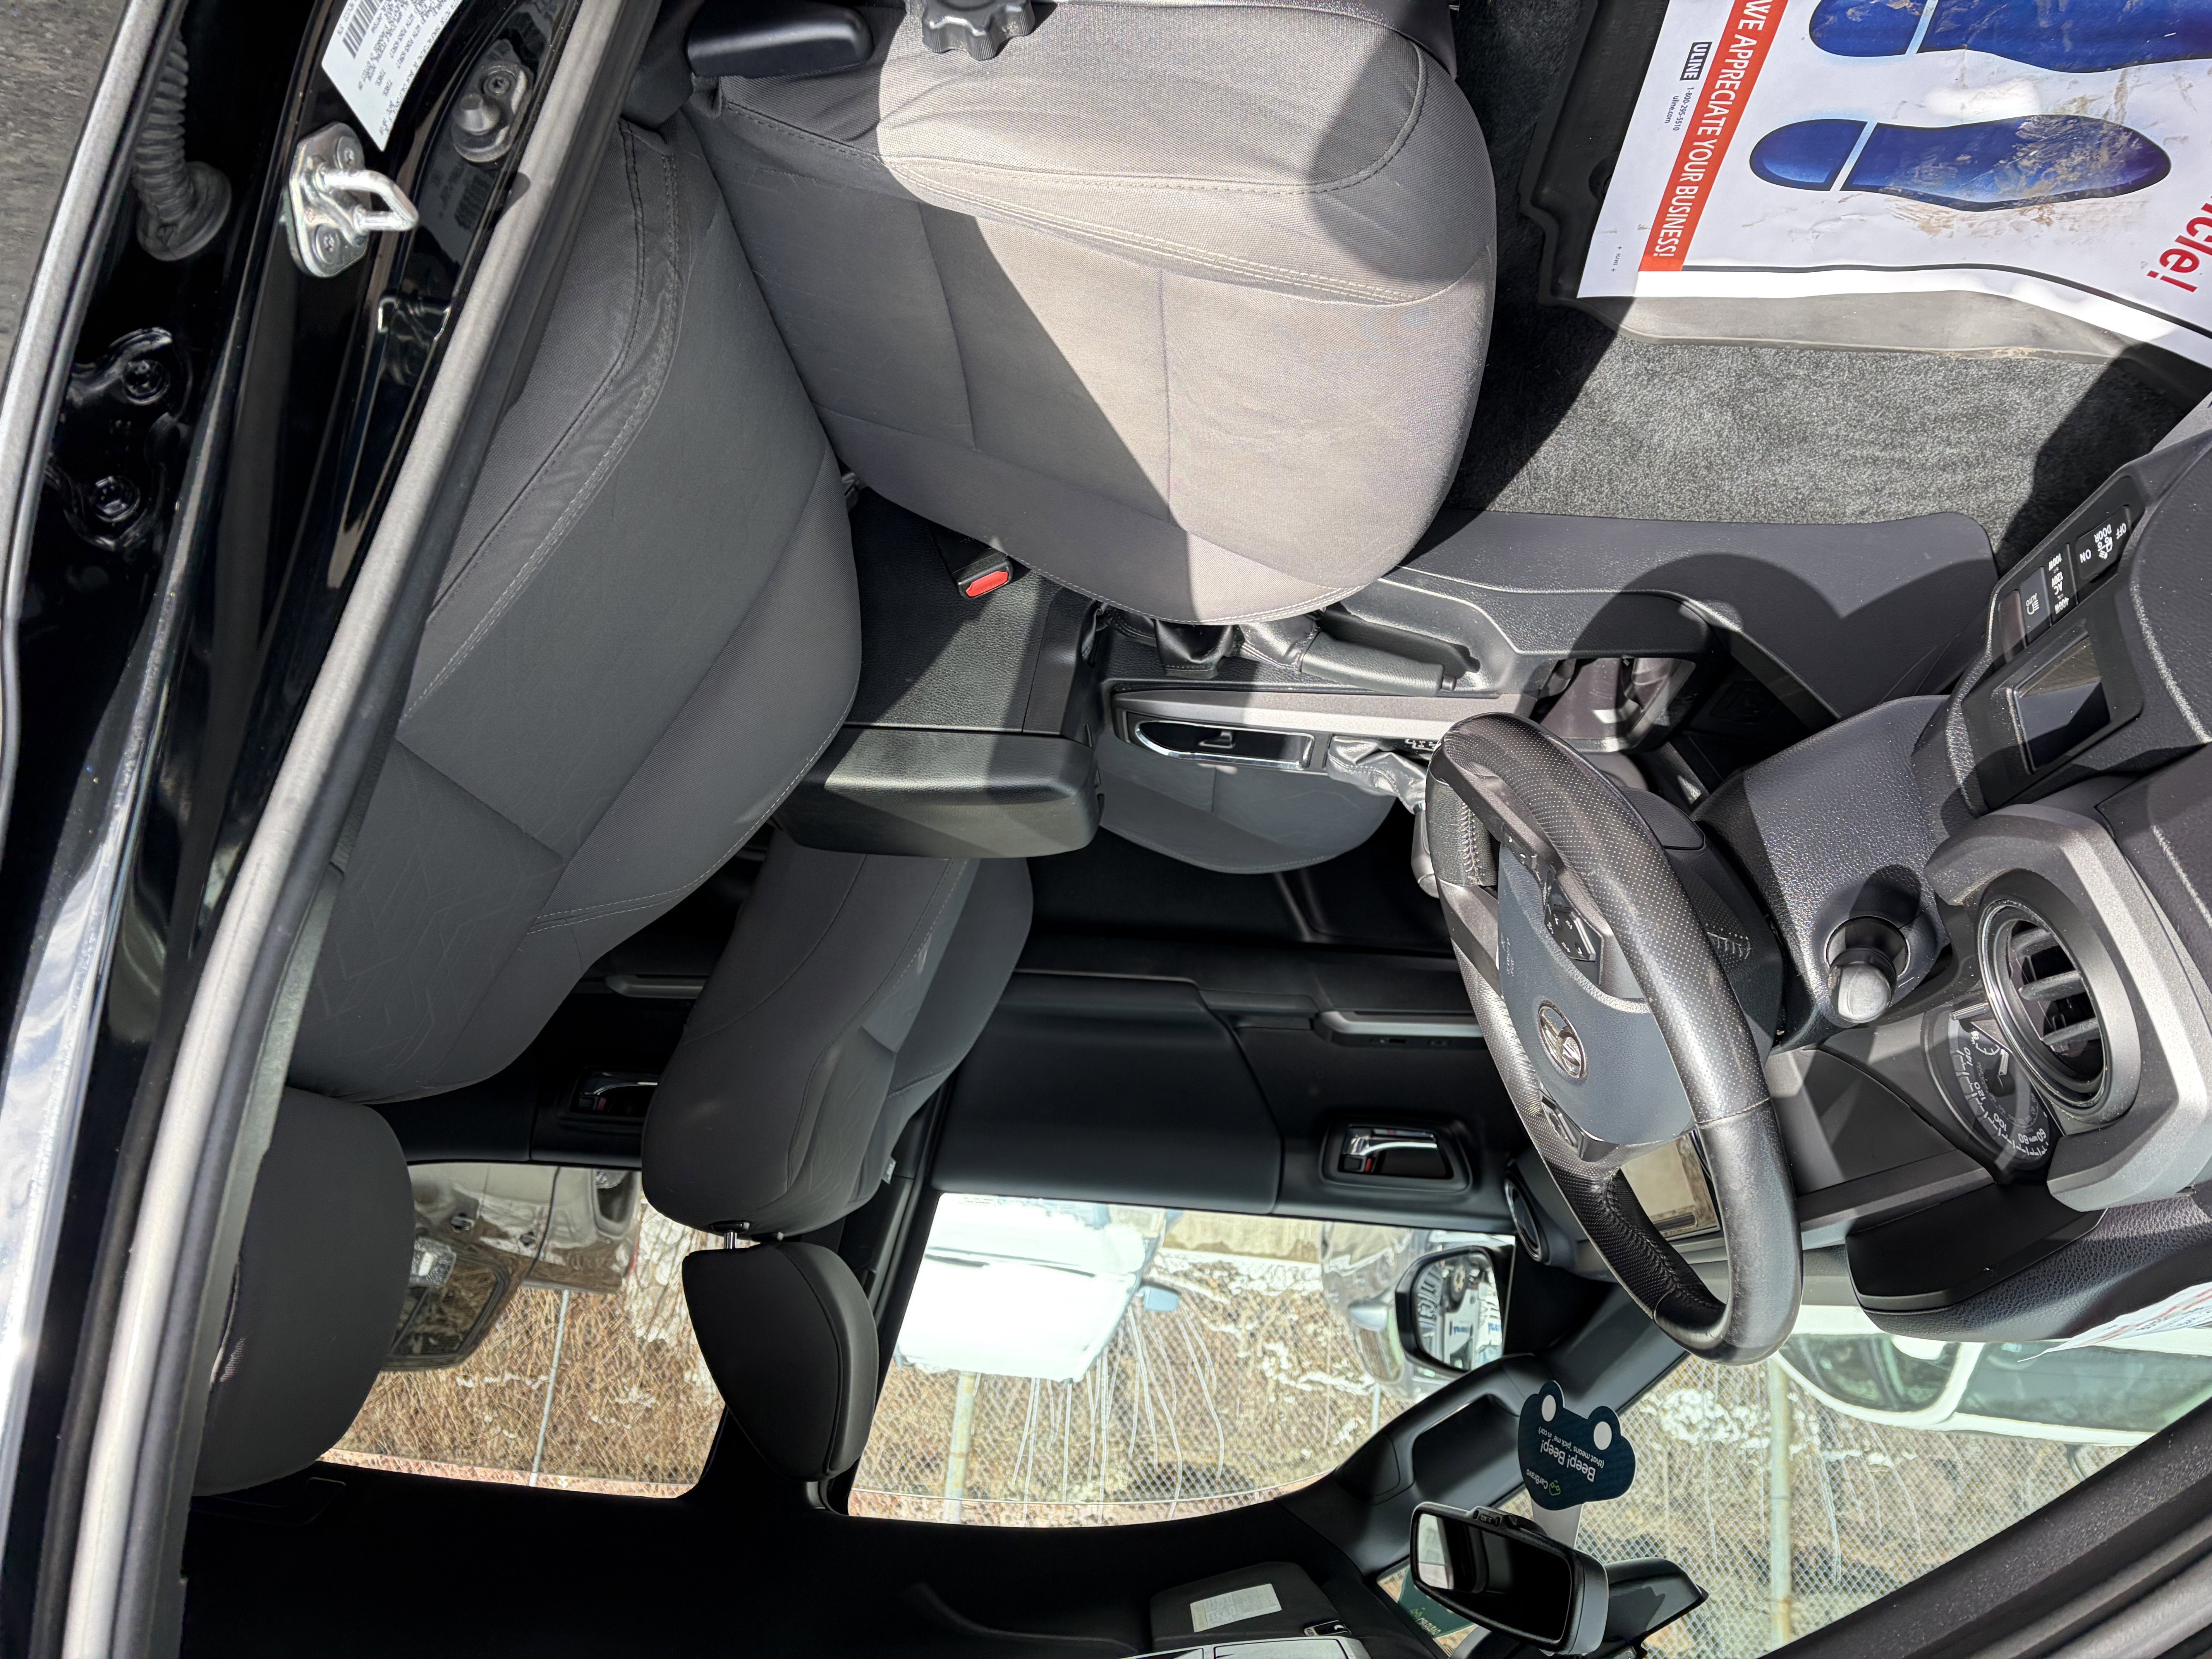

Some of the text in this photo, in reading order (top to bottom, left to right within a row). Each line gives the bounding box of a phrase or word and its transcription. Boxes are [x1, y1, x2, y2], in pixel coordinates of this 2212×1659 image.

[1683, 44, 1709, 79] ULINE
[1664, 96, 1679, 124] uline.com
[1673, 87, 1694, 131] 1-800-295-5510
[1653, 0, 1772, 256] WE APPRECIATE YOUR BUSINESS!
[2094, 524, 2112, 543] DOOR
[2116, 523, 2127, 539] OFF
[2049, 553, 2062, 571] 100W
[2080, 549, 2091, 563] ON
[2052, 571, 2063, 588] 120V
[2054, 581, 2063, 595] AC
[2026, 592, 2037, 607] AUTO
[2055, 597, 2069, 615] 400W
[1964, 1047, 1973, 1066] 140
[1974, 1081, 1986, 1101] 120
[1994, 1113, 2007, 1132] 100
[2018, 1133, 2029, 1145] 80
[2036, 1128, 2047, 1142] 60
[1538, 1426, 1547, 1436] car)
[1540, 1439, 1596, 1482] Beep! Beep!
[1573, 1446, 1590, 1459] means
[1591, 1455, 1604, 1469] (that
[1526, 1468, 1549, 1490] CarBravo
